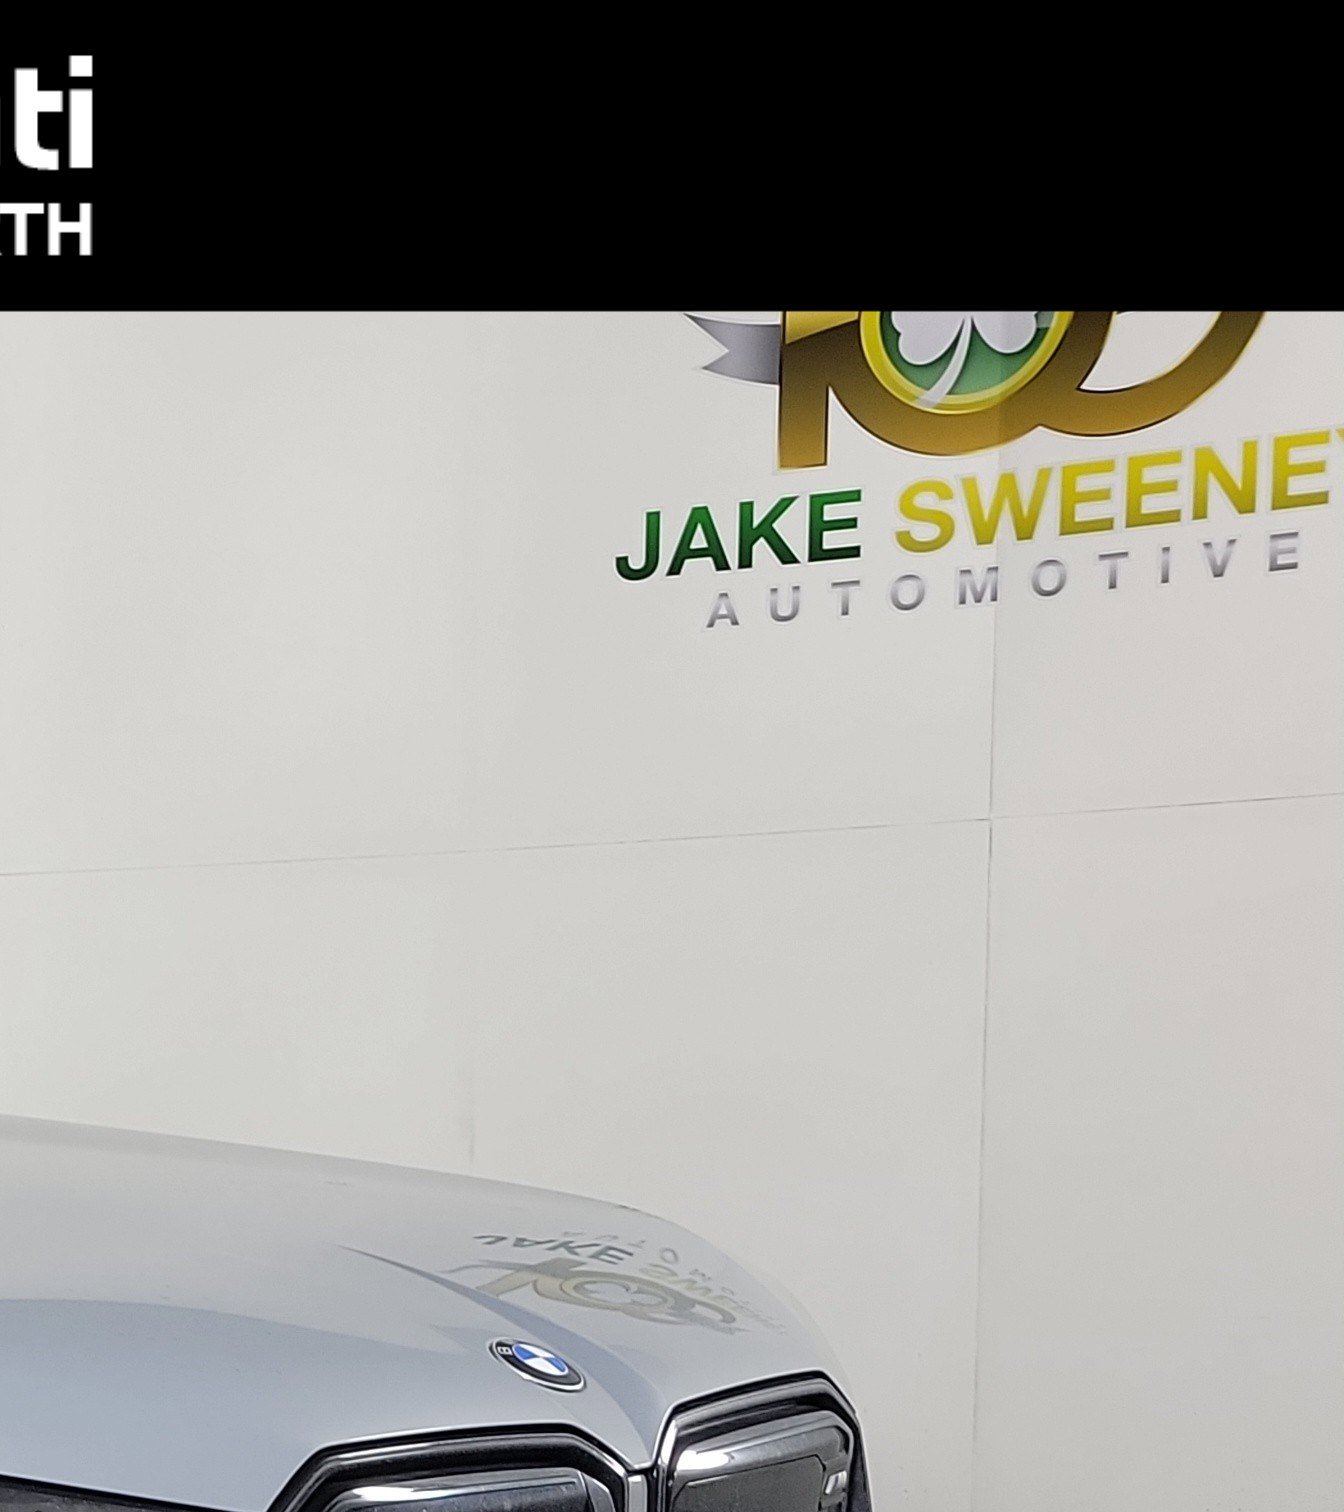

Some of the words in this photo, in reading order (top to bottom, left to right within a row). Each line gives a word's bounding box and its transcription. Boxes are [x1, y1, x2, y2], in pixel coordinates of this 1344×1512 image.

[615, 489, 863, 581] JAKE
[894, 427, 1344, 553] SWEENE
[706, 531, 1300, 628] AUTOMOTIVE
